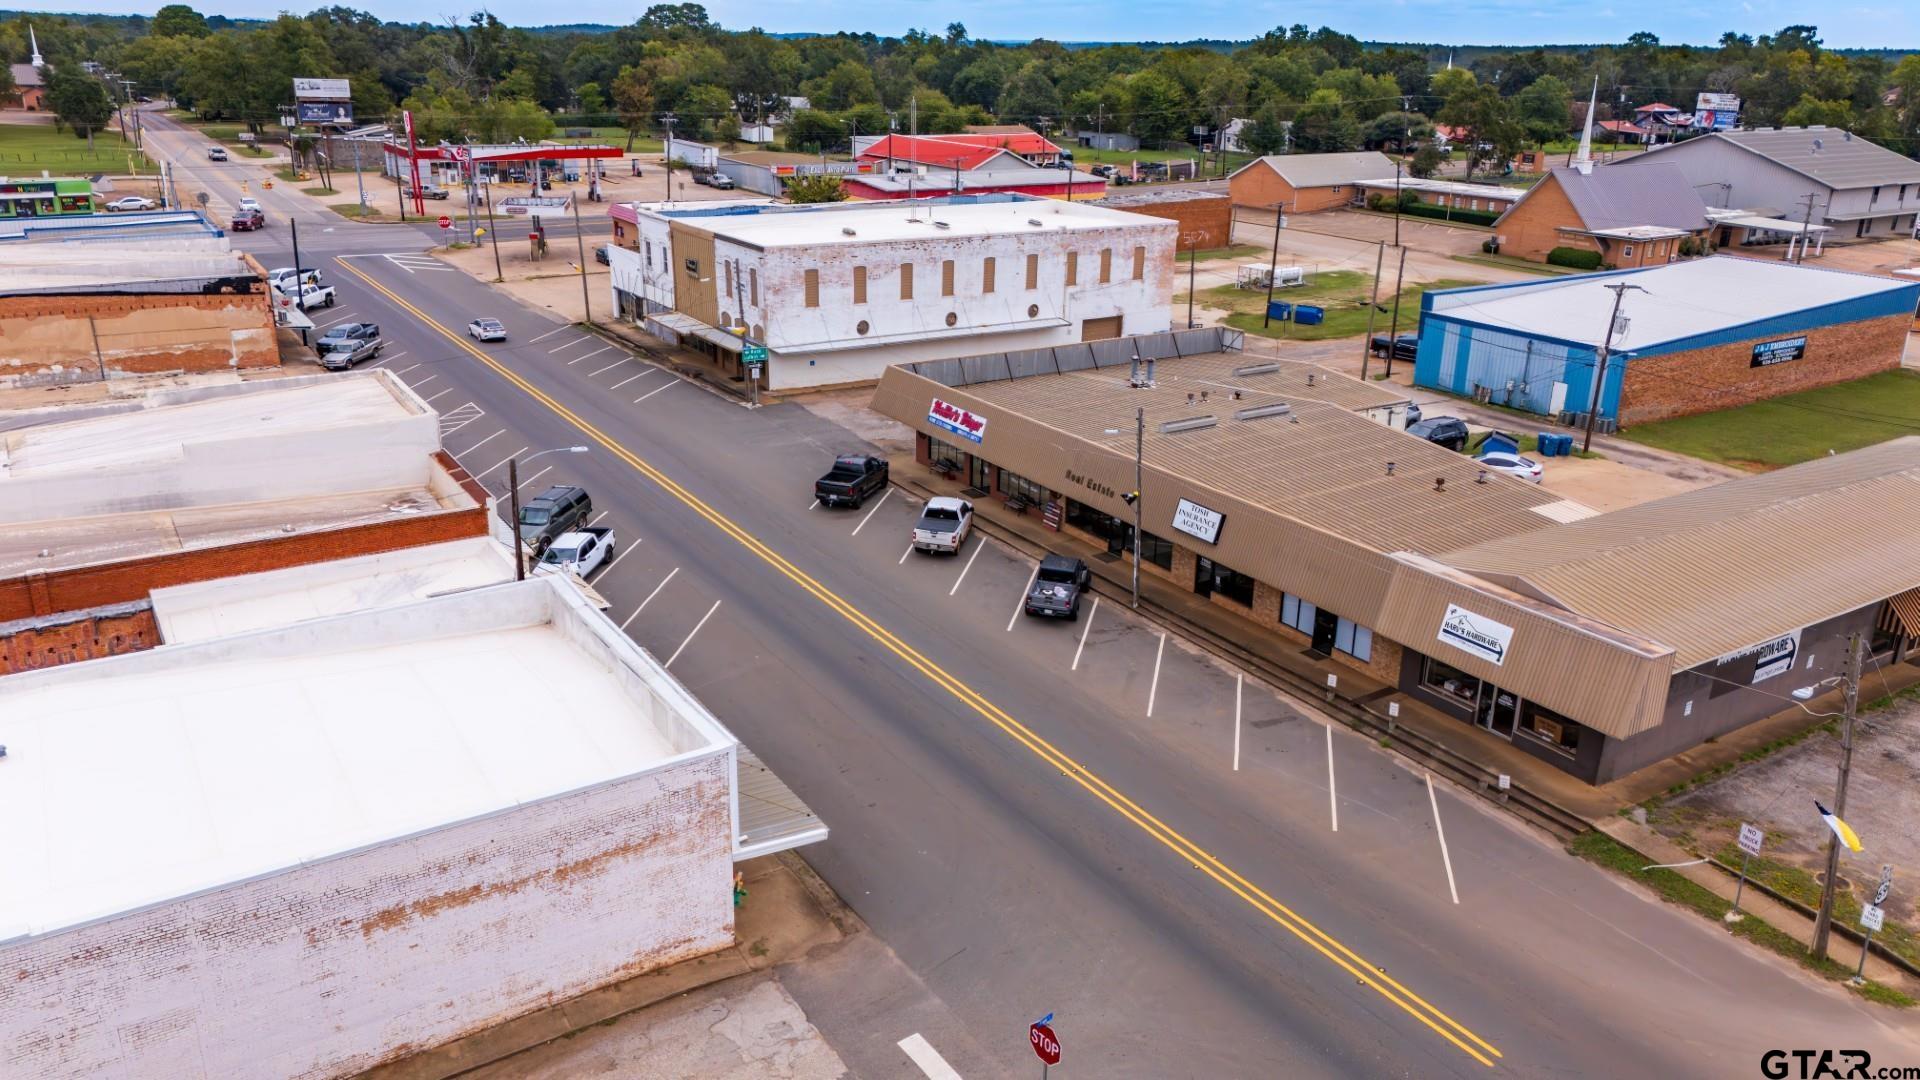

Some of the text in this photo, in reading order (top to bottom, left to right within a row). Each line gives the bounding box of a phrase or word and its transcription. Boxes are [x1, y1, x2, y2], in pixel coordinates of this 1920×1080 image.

[1065, 469, 1115, 499] Real Estate
[1178, 508, 1216, 529] INSURANCE
[1191, 504, 1210, 518] TOSH
[1183, 518, 1208, 535] AGENCY
[1466, 629, 1498, 649] HARDWARE
[1747, 827, 1757, 837] NO
[1031, 1028, 1060, 1056] STOP
